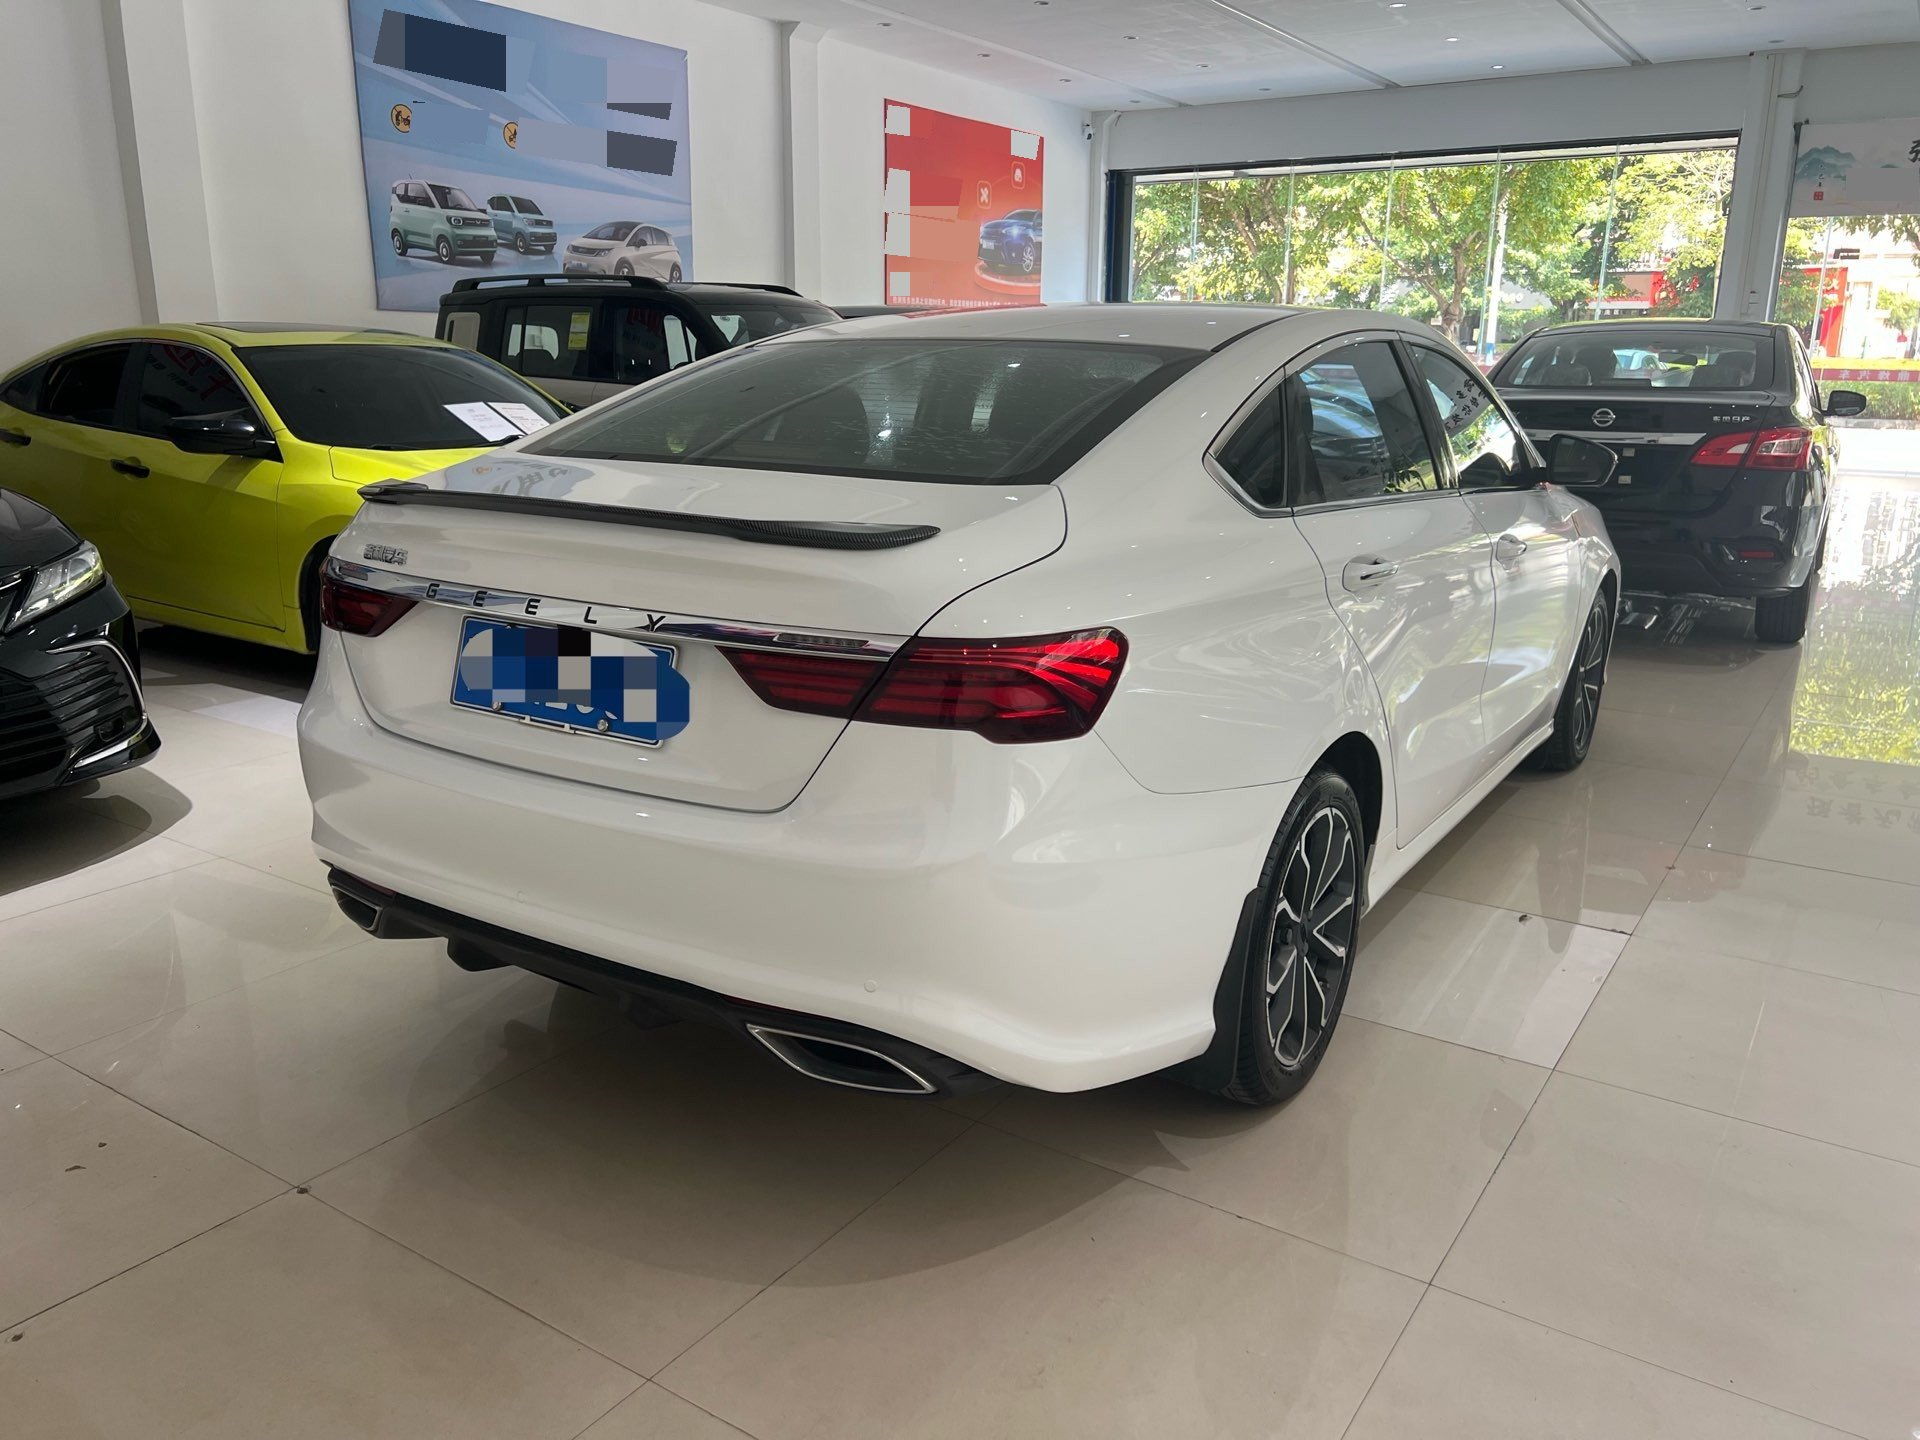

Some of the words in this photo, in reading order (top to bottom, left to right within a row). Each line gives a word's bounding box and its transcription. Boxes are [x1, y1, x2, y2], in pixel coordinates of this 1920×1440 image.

[363, 543, 409, 566] 吉利汽车
[425, 582, 666, 633] GEELY
